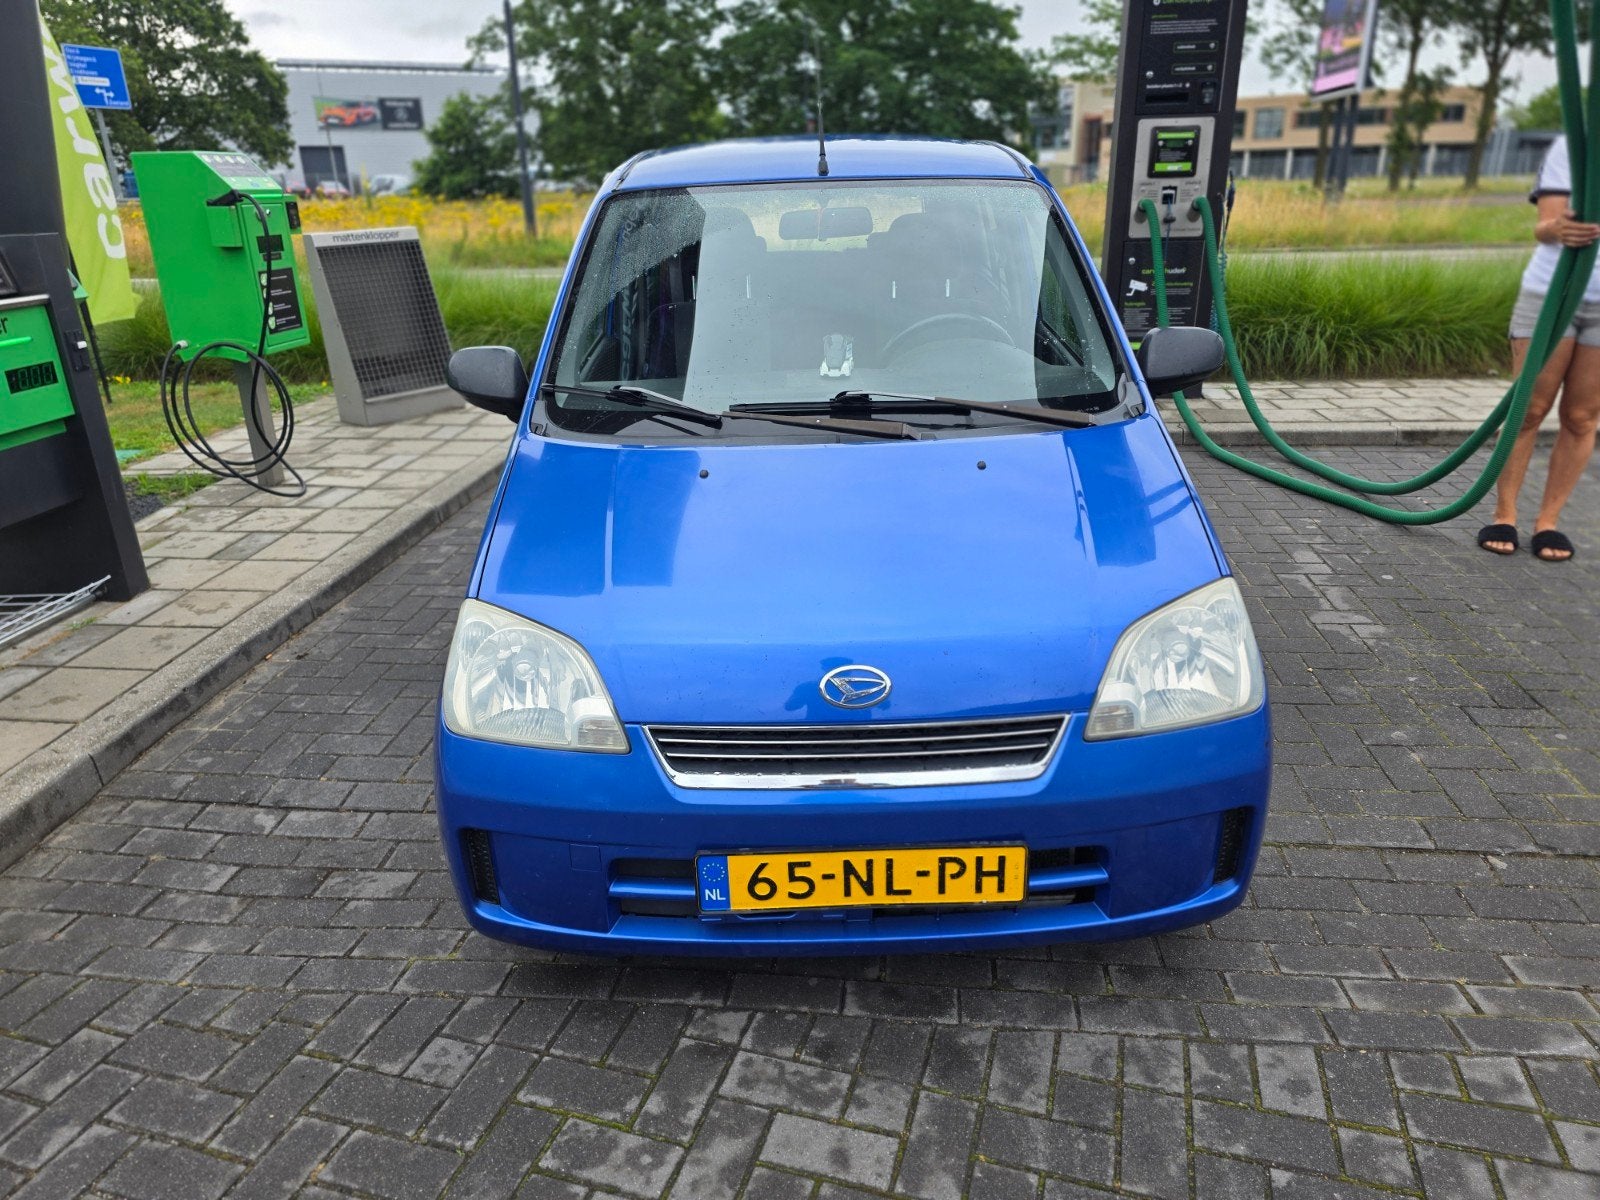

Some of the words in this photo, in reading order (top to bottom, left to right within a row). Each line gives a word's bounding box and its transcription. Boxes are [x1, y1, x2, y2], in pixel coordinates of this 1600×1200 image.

[40, 20, 126, 258] carw
[332, 230, 399, 242] mattenklopper
[1141, 267, 1186, 275] carhuden
[747, 855, 1006, 900] 65-NL-PH
[705, 889, 726, 901] NL
